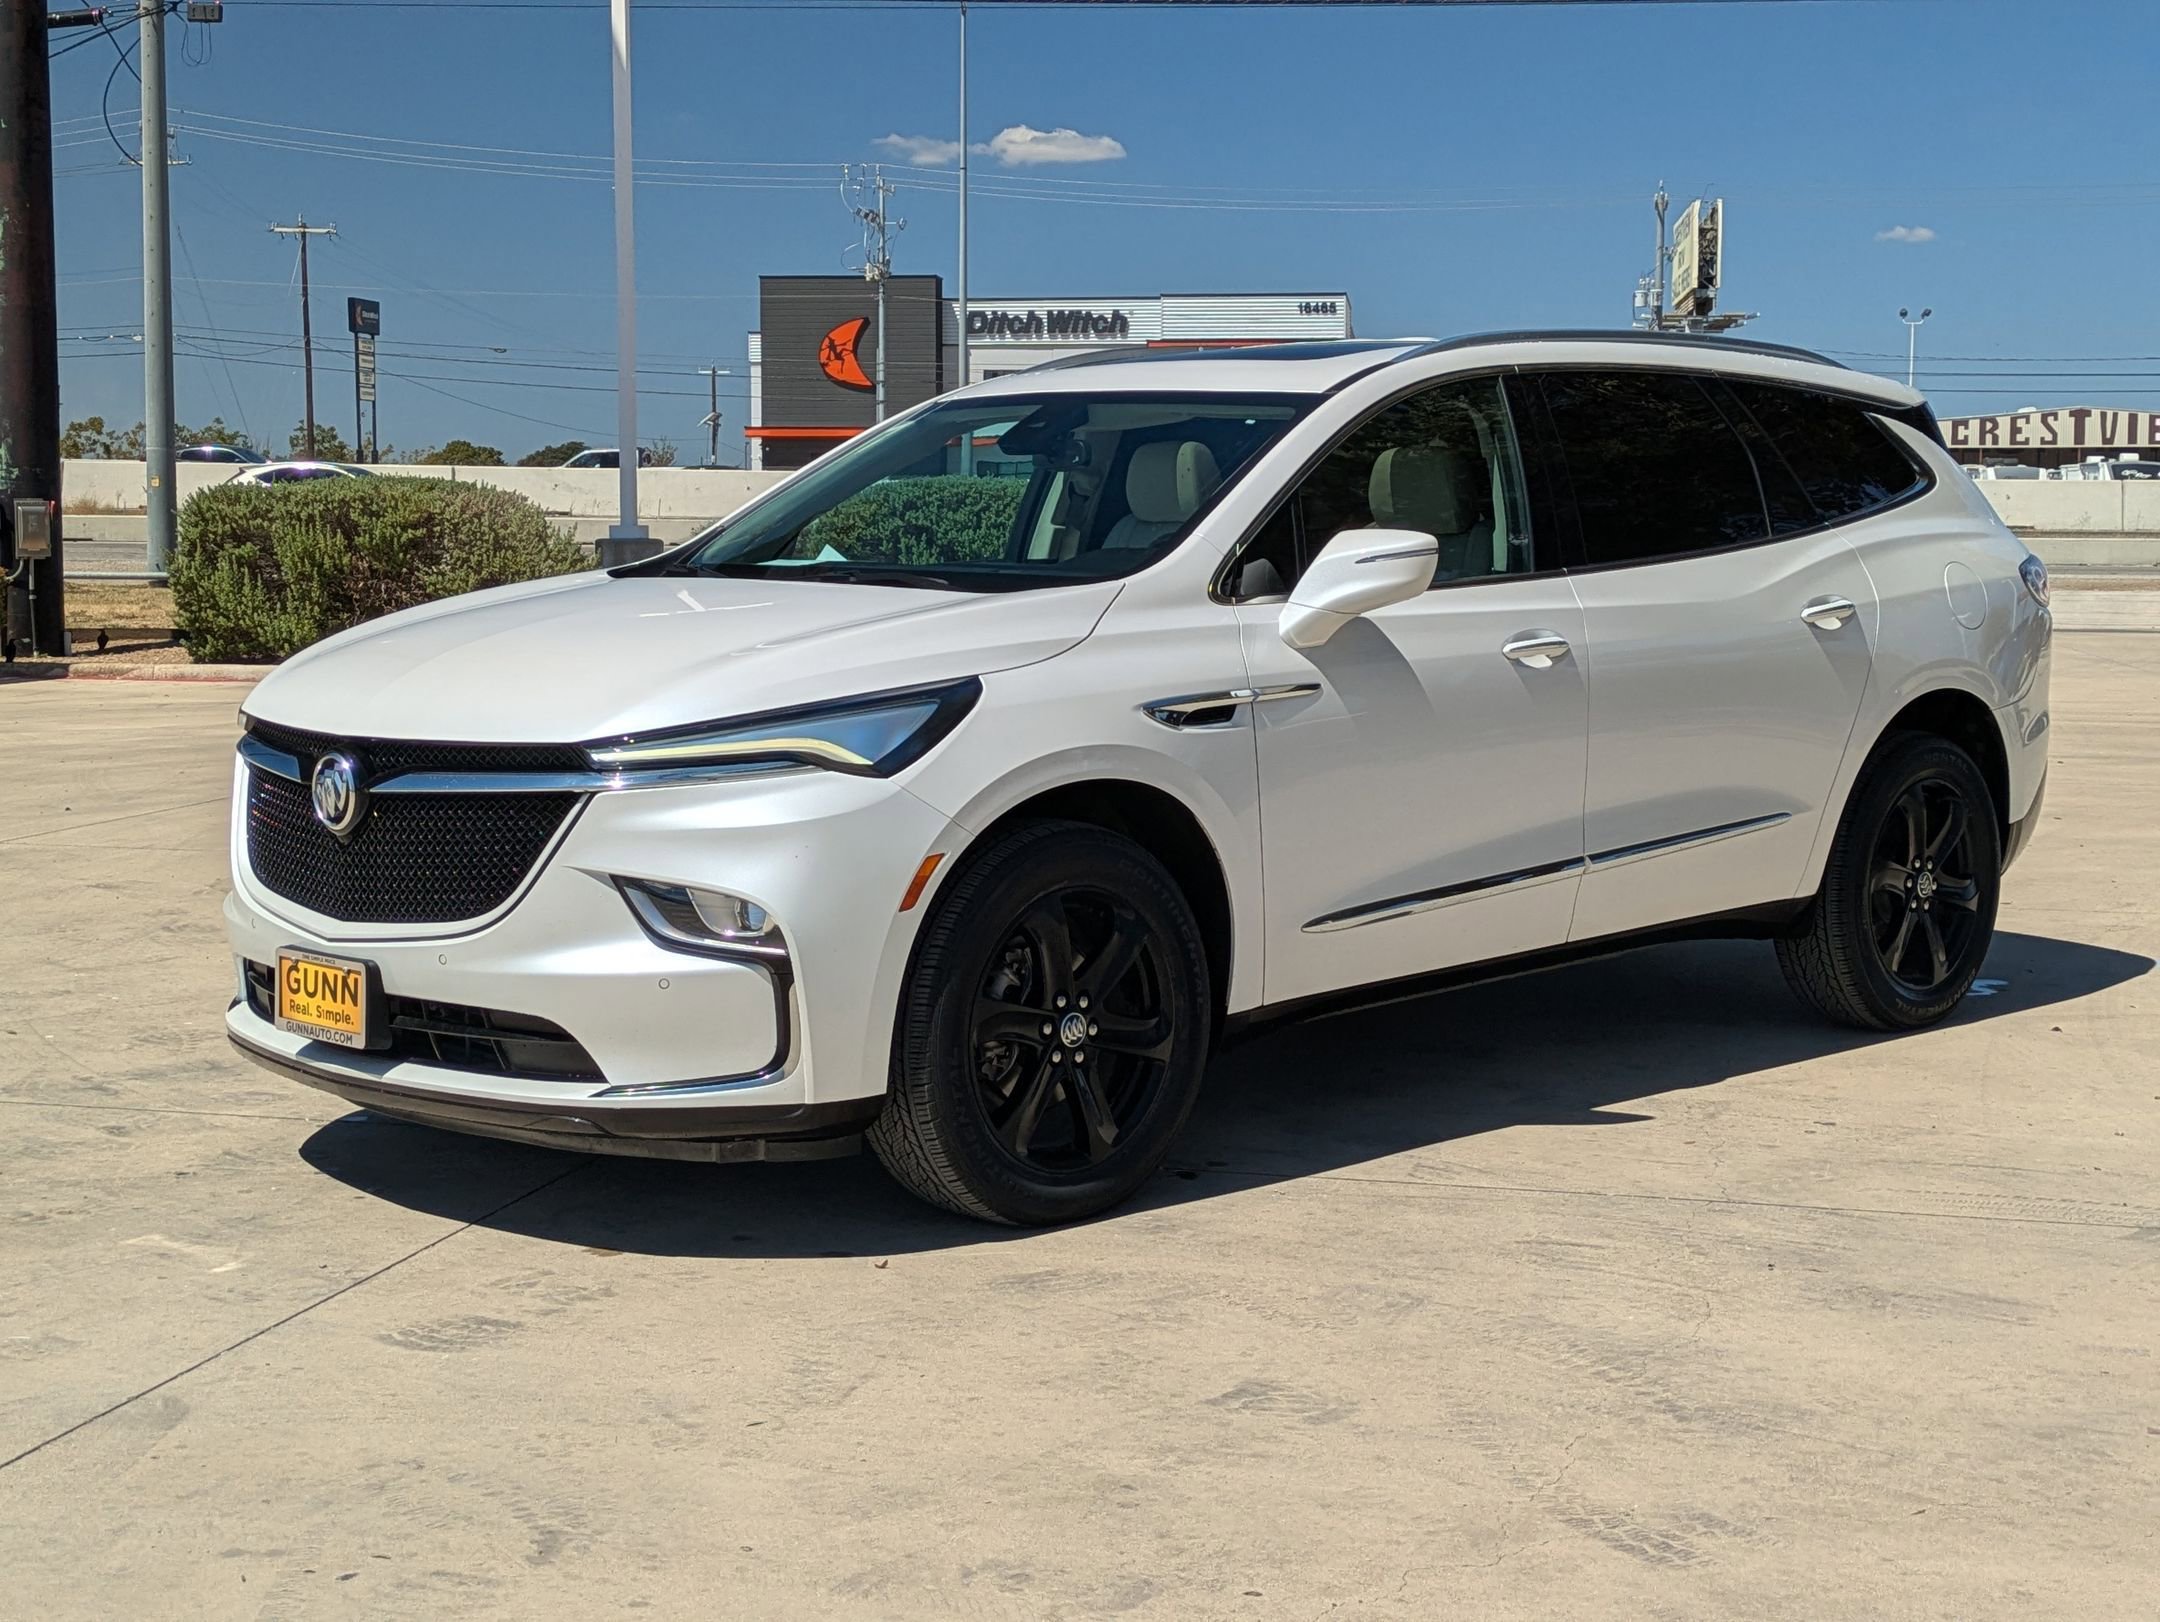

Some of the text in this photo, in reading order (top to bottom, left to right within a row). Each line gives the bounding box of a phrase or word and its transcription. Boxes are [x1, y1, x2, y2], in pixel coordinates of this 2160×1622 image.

[968, 309, 1129, 335] Ditch Witch
[286, 963, 359, 1008] GUNN
[289, 998, 313, 1017] Real.
[286, 1020, 353, 1046] GUNNAUTO.COM
